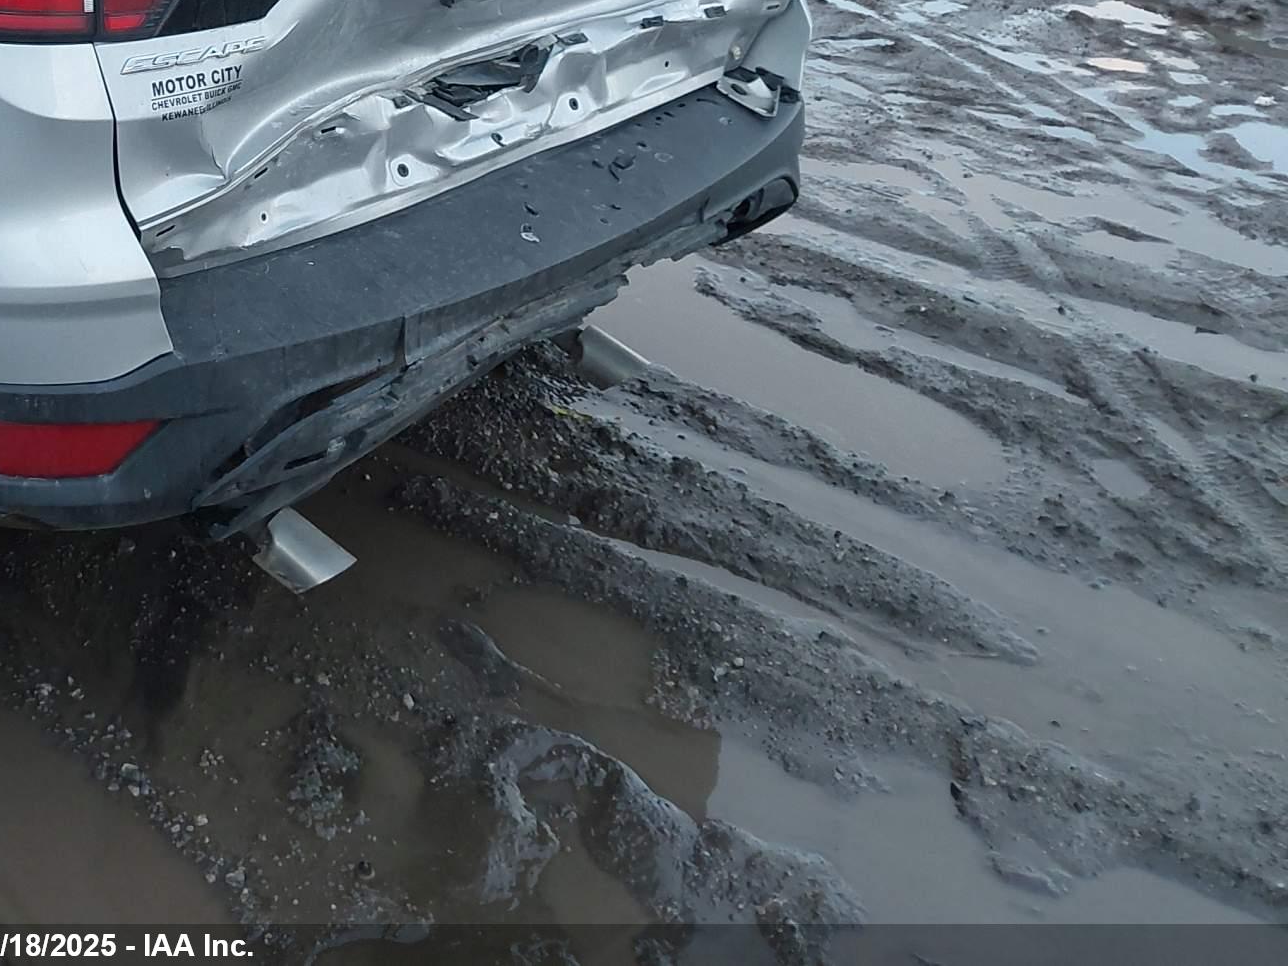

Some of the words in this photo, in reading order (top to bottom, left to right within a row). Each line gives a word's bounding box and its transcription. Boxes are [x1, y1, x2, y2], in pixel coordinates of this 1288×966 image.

[120, 36, 265, 75] ESCAPE
[152, 73, 207, 98] MOTOR
[211, 64, 243, 85] CITY
[151, 93, 203, 111] CHEVROLET
[204, 87, 226, 100] BUICK
